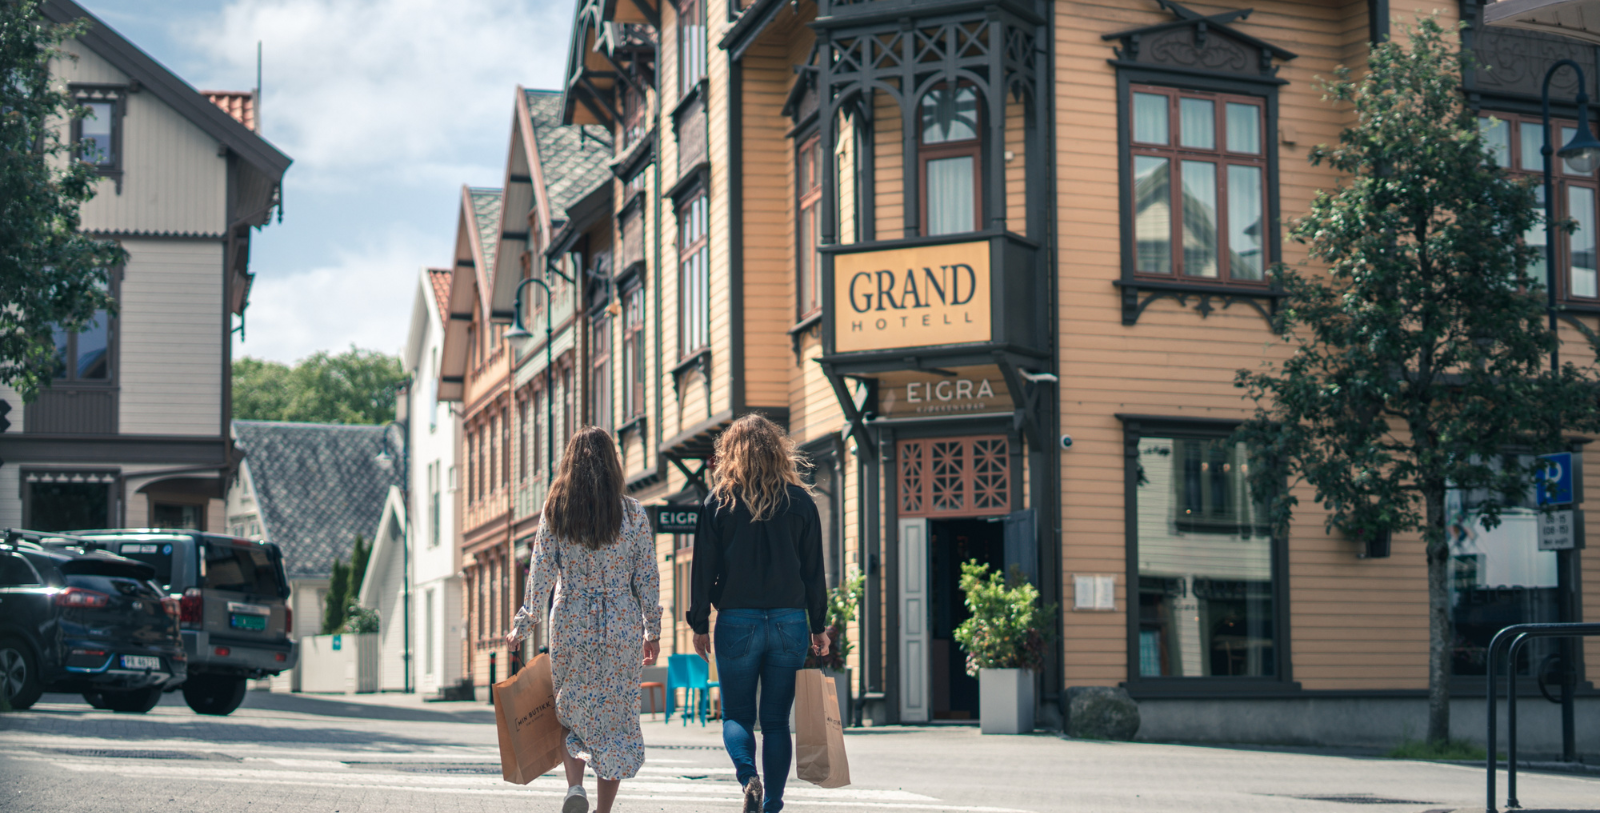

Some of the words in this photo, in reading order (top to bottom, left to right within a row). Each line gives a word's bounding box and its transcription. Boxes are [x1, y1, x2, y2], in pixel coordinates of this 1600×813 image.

[849, 264, 976, 313] GRAND
[852, 312, 973, 332] HOTELL
[907, 378, 994, 403] EIGRA
[660, 512, 698, 524] EIGR
[518, 715, 527, 726] MIN
[529, 701, 551, 718] BUTIKK
